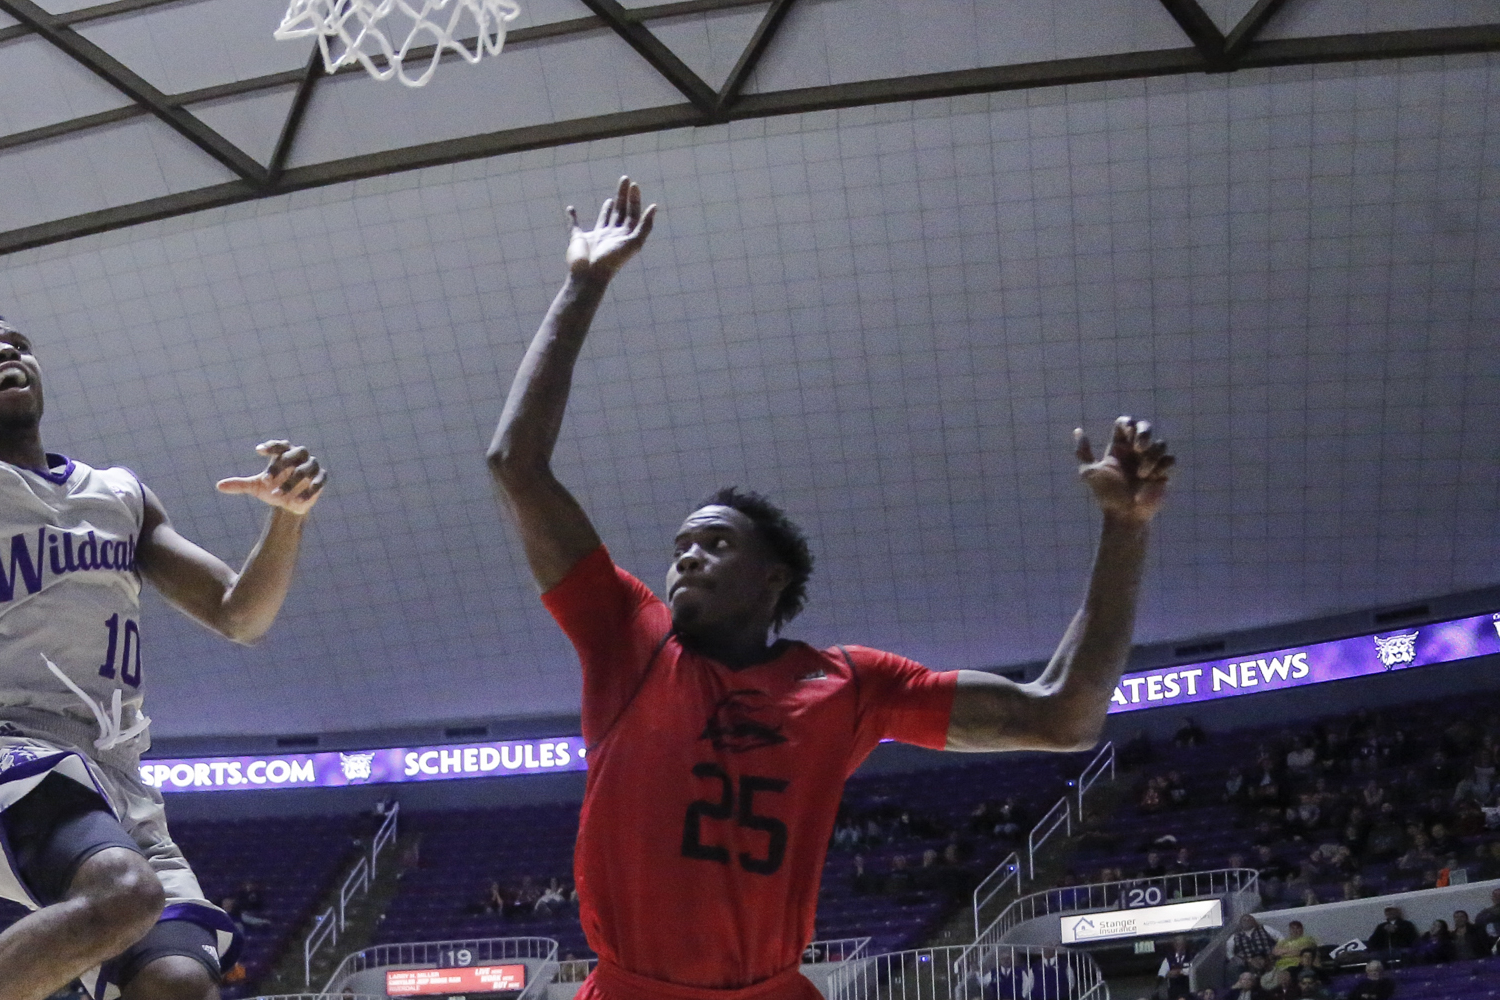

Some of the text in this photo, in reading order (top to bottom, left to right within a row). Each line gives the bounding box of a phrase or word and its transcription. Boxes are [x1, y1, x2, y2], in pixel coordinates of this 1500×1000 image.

[98, 612, 141, 689] 10
[1110, 652, 1310, 705] ATEST NEWS
[138, 759, 315, 788] SPORTS.COM
[404, 742, 571, 777] SCHEDULES
[681, 762, 791, 876] 25
[1128, 887, 1162, 908] 20
[448, 949, 472, 966] 19
